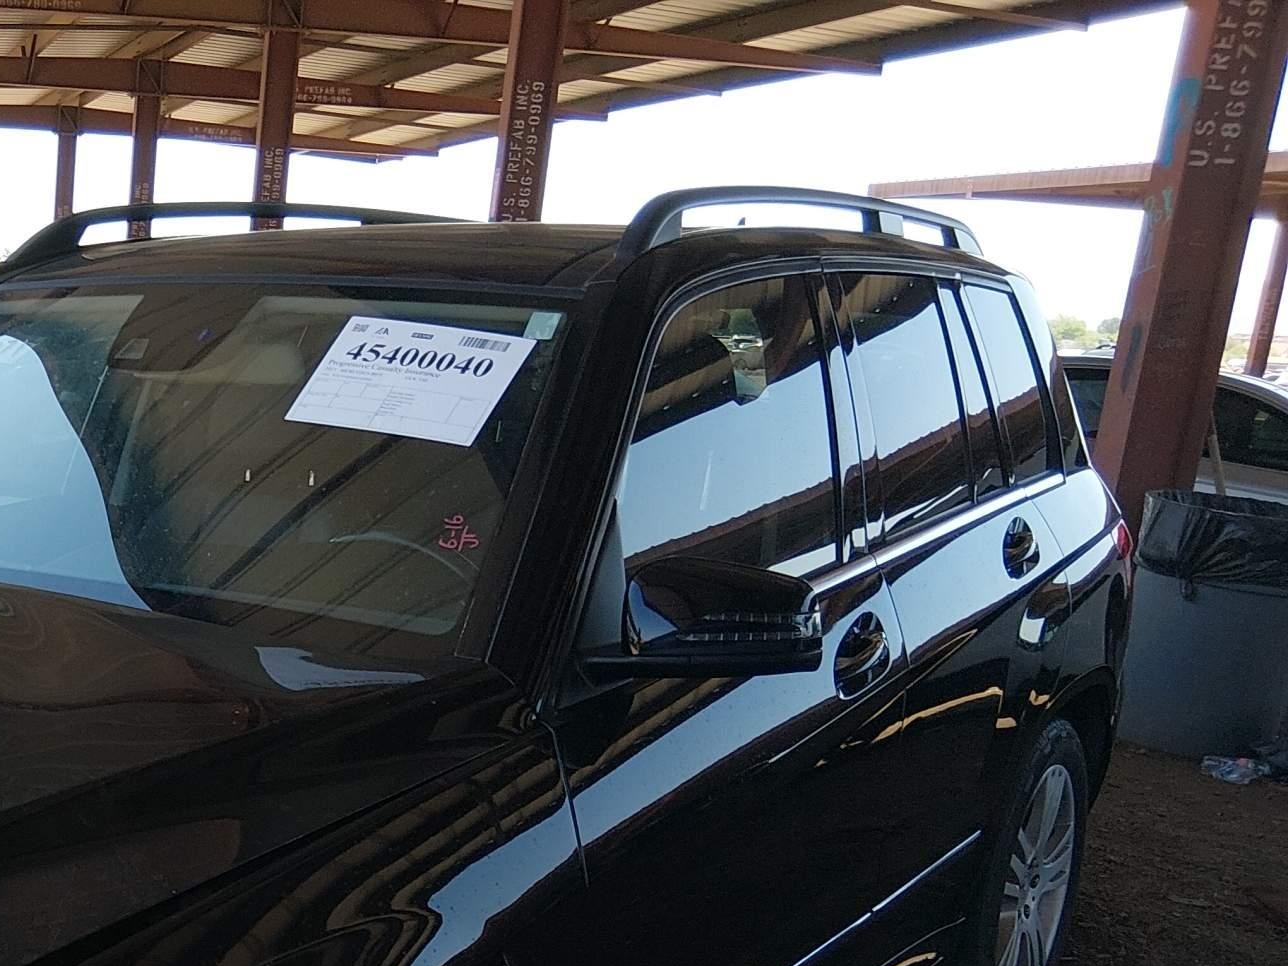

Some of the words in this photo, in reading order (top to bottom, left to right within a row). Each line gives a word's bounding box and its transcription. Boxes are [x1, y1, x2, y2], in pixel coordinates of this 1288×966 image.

[505, 119, 526, 183] PREFAB
[516, 79, 531, 111] INC.
[1188, 111, 1220, 167] U.S.
[1204, 0, 1242, 91] PREF
[515, 80, 546, 223] 1-866-799-0969
[345, 341, 494, 378] 45400040
